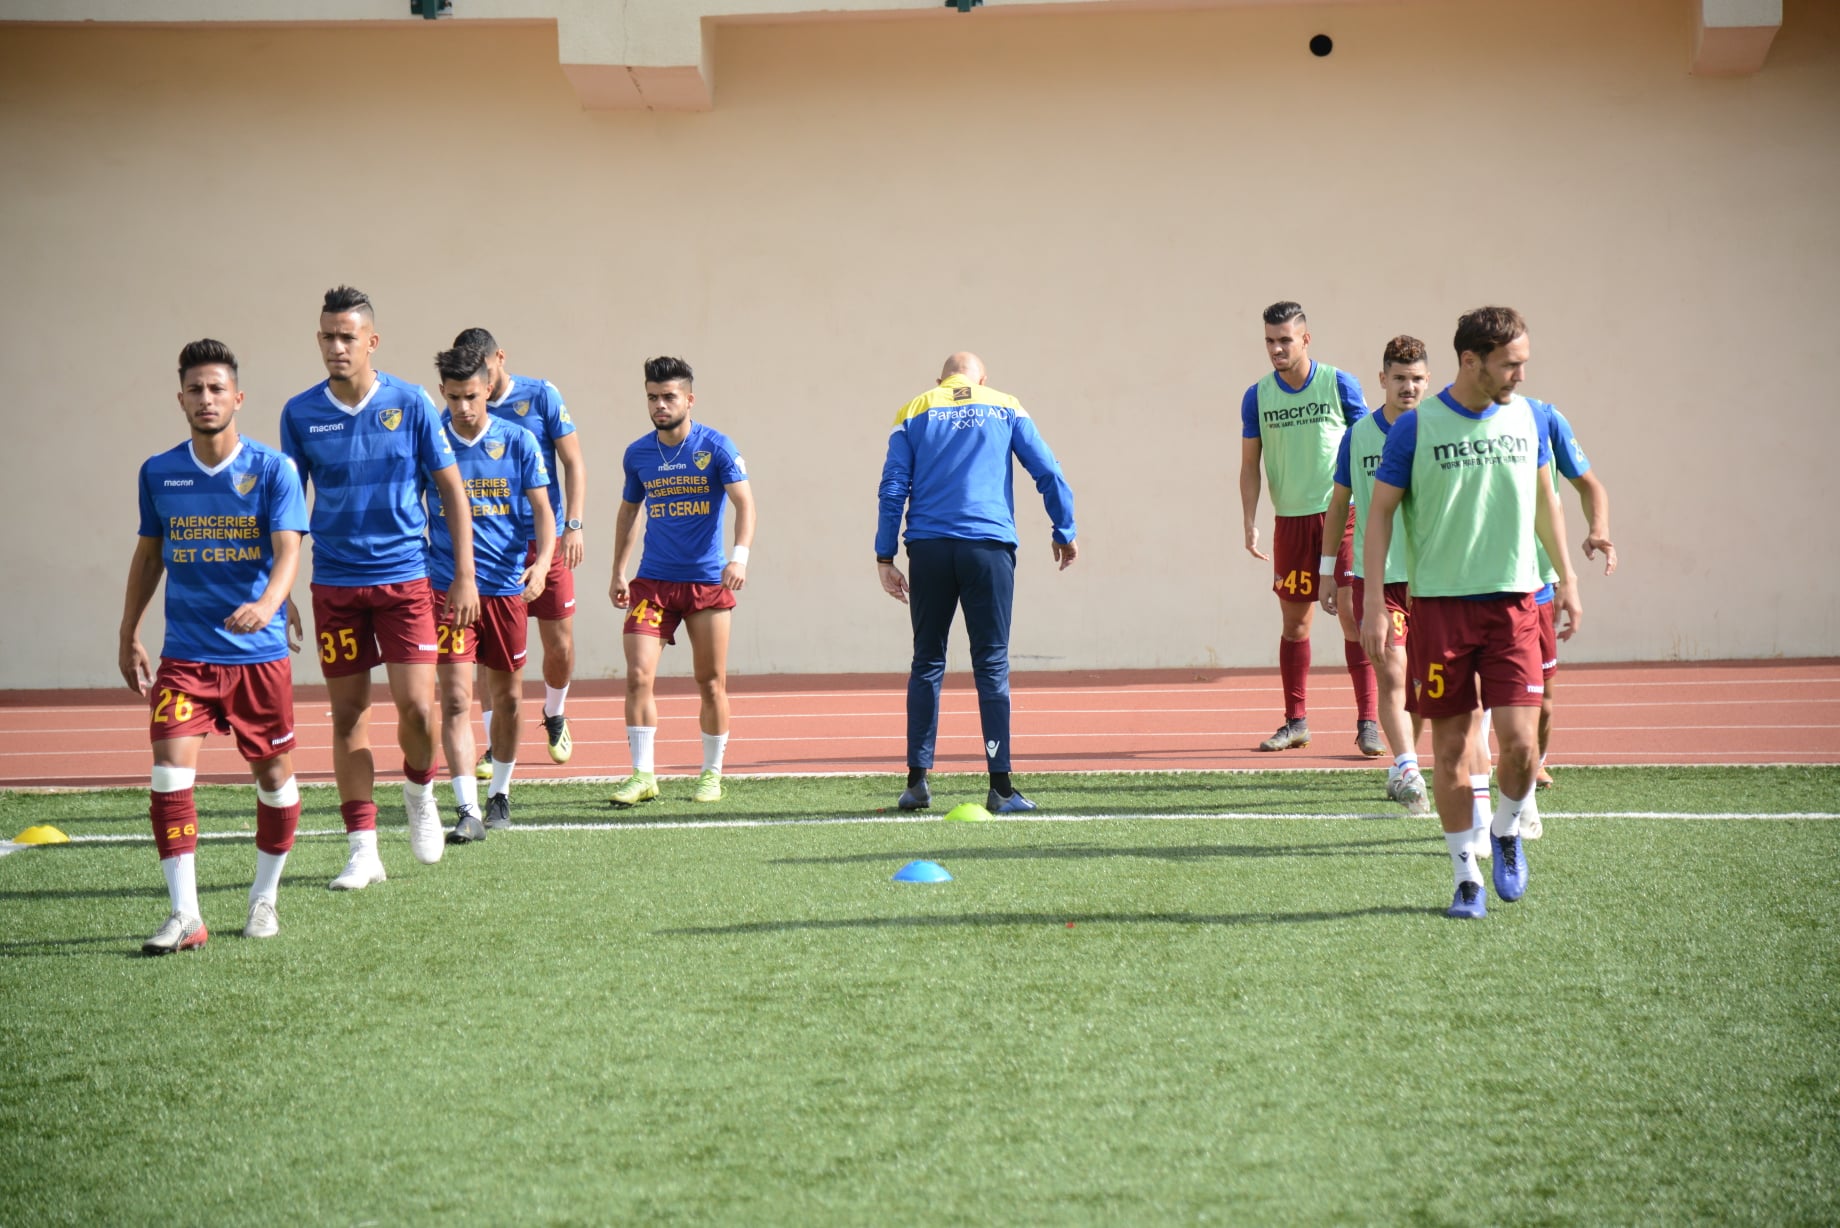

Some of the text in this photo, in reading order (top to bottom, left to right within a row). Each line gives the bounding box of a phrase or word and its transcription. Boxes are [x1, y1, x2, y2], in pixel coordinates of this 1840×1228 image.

[928, 407, 1008, 421] Paradou AC
[1263, 402, 1331, 422] macron
[309, 422, 345, 433] macron
[952, 418, 986, 430] XXIV
[1433, 434, 1529, 462] macron
[657, 462, 687, 472] macron
[1440, 460, 1460, 471] WORK
[163, 479, 194, 487] macron
[643, 475, 708, 489] FAIENCERIES
[647, 485, 710, 498] ALGERIENNES
[471, 503, 510, 517] ERAM
[649, 501, 711, 518] ZET CERAM
[169, 515, 257, 529] FAIENCERIES
[170, 527, 260, 541] ALGERIENNES
[173, 546, 262, 563] ZET CERAM
[1283, 569, 1313, 595] 45
[631, 598, 664, 628] 43
[320, 628, 358, 664] 35
[437, 624, 466, 655] 28
[1427, 662, 1445, 699] 5
[153, 688, 194, 723] 26
[166, 823, 196, 839] 26
